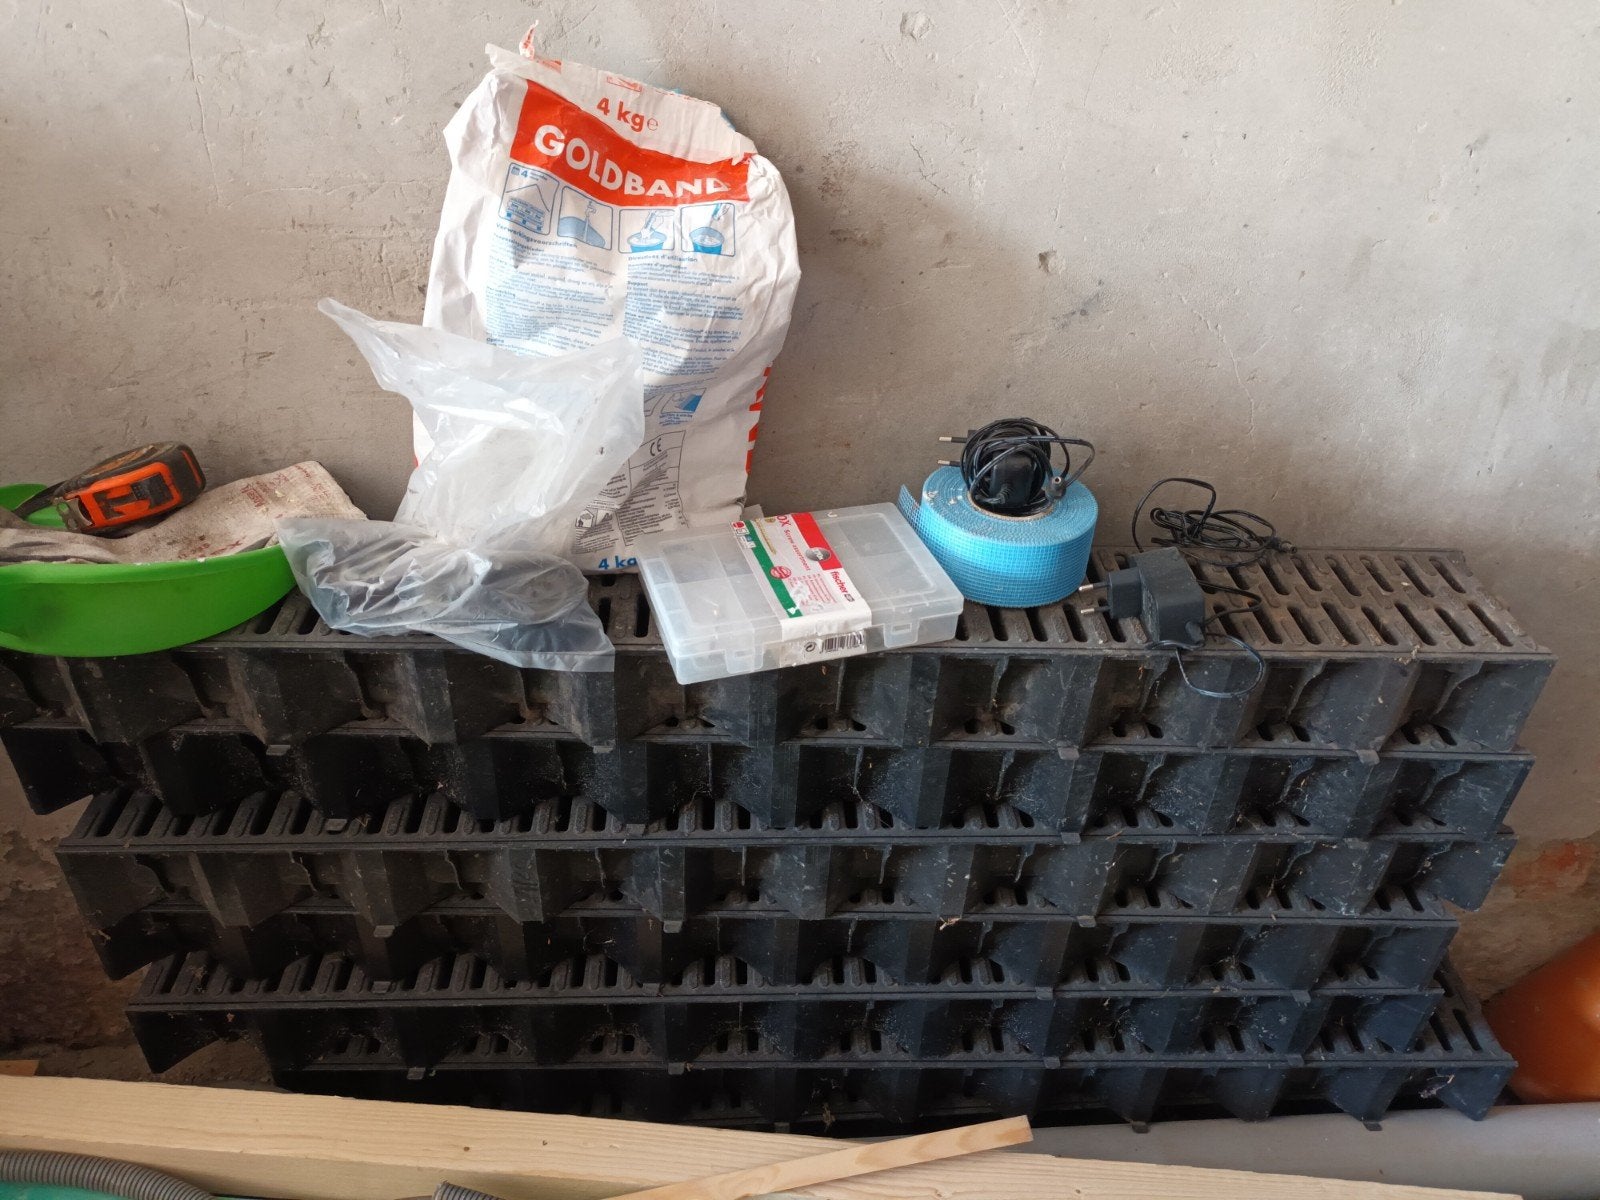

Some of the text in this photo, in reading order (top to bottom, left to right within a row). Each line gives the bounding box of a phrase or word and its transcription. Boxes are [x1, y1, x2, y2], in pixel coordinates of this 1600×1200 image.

[596, 97, 610, 116] 4
[534, 124, 731, 198] GOLDBAND
[598, 557, 609, 570] 4
[831, 571, 848, 593] fischer
